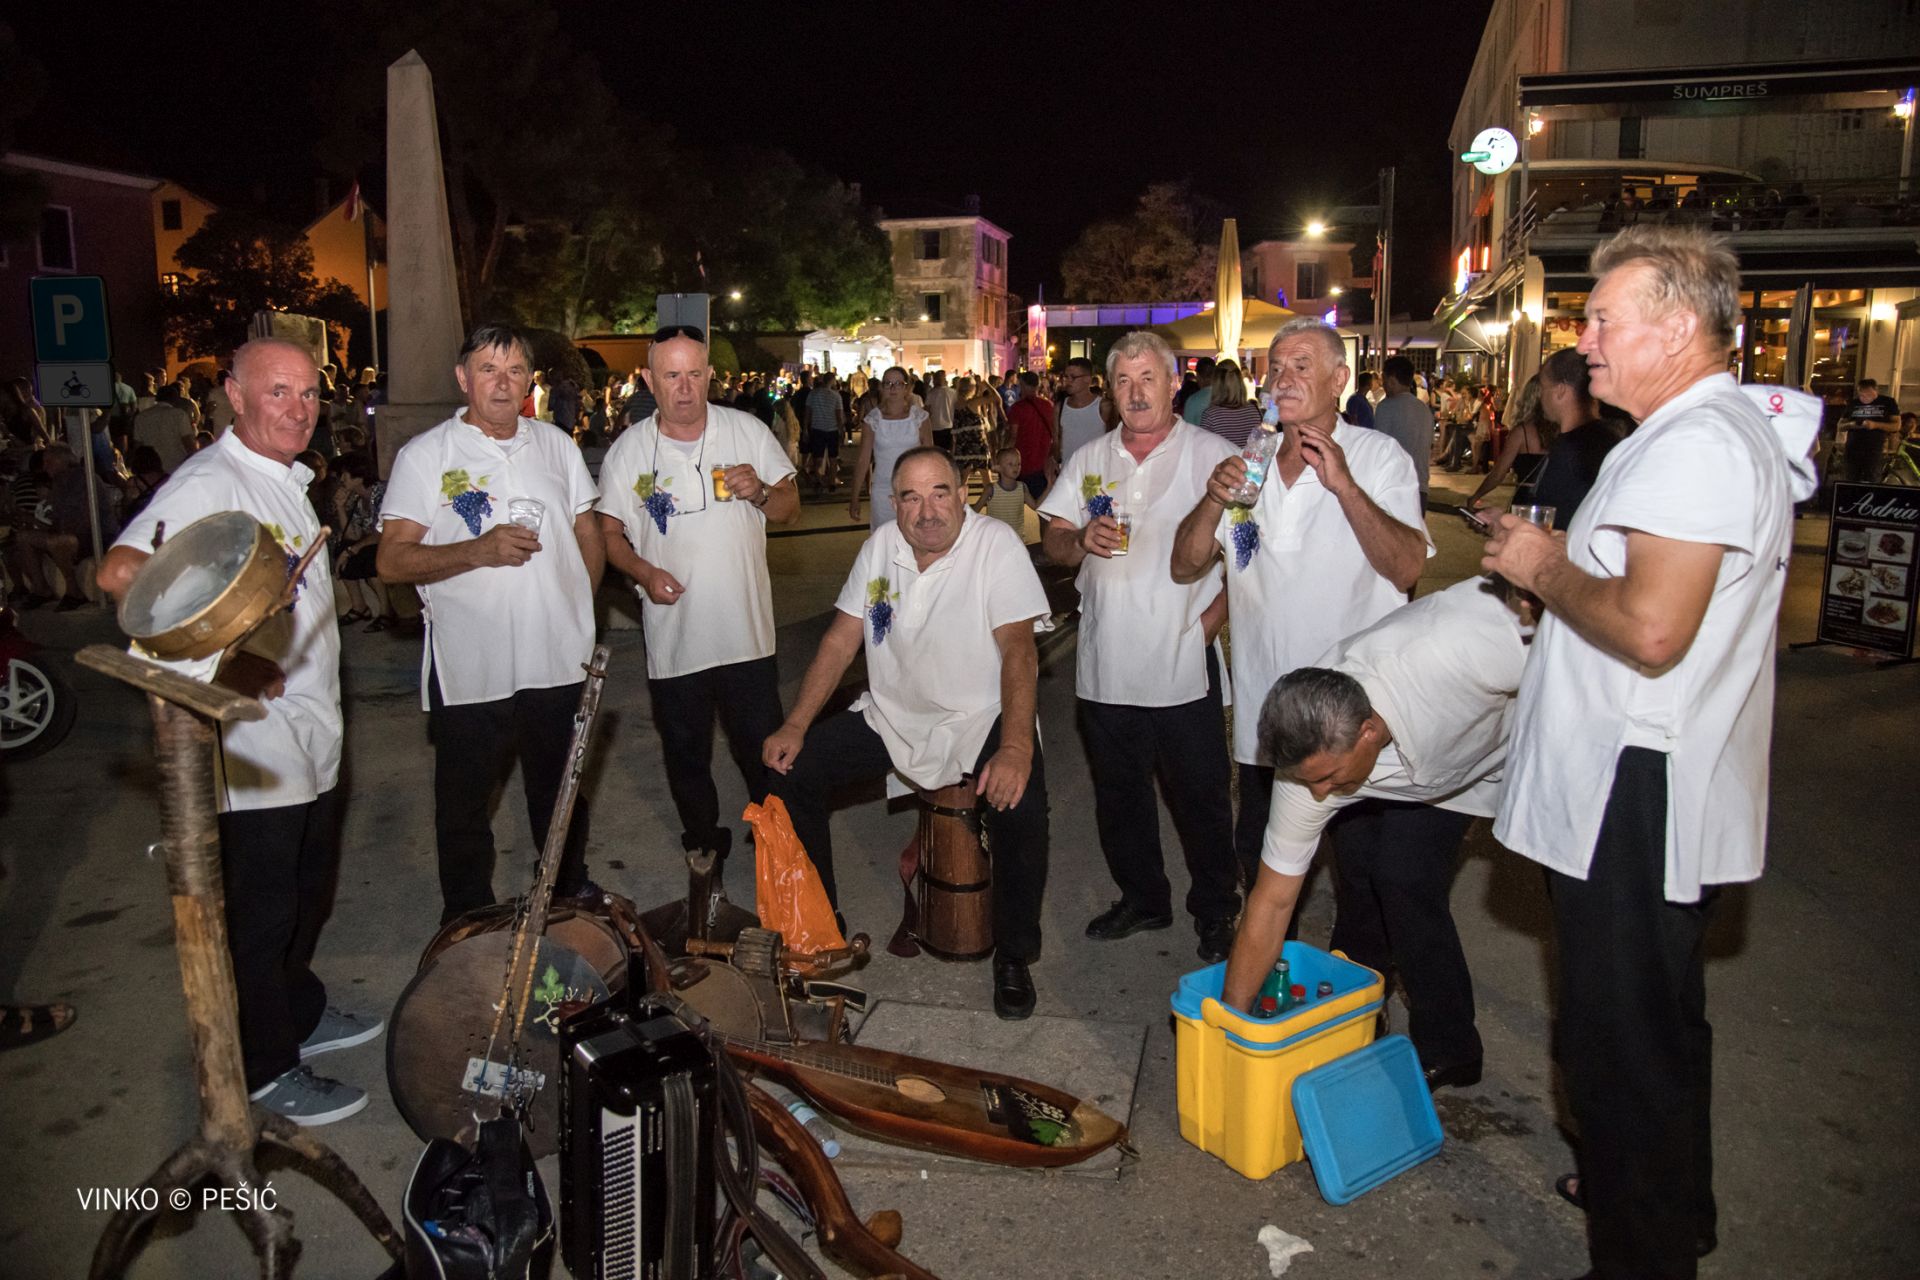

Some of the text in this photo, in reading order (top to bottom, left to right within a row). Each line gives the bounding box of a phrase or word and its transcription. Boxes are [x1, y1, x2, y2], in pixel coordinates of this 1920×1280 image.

[1673, 82, 1768, 98] ŠUMPREŠ
[53, 294, 84, 345] P
[1838, 491, 1920, 521] Adria
